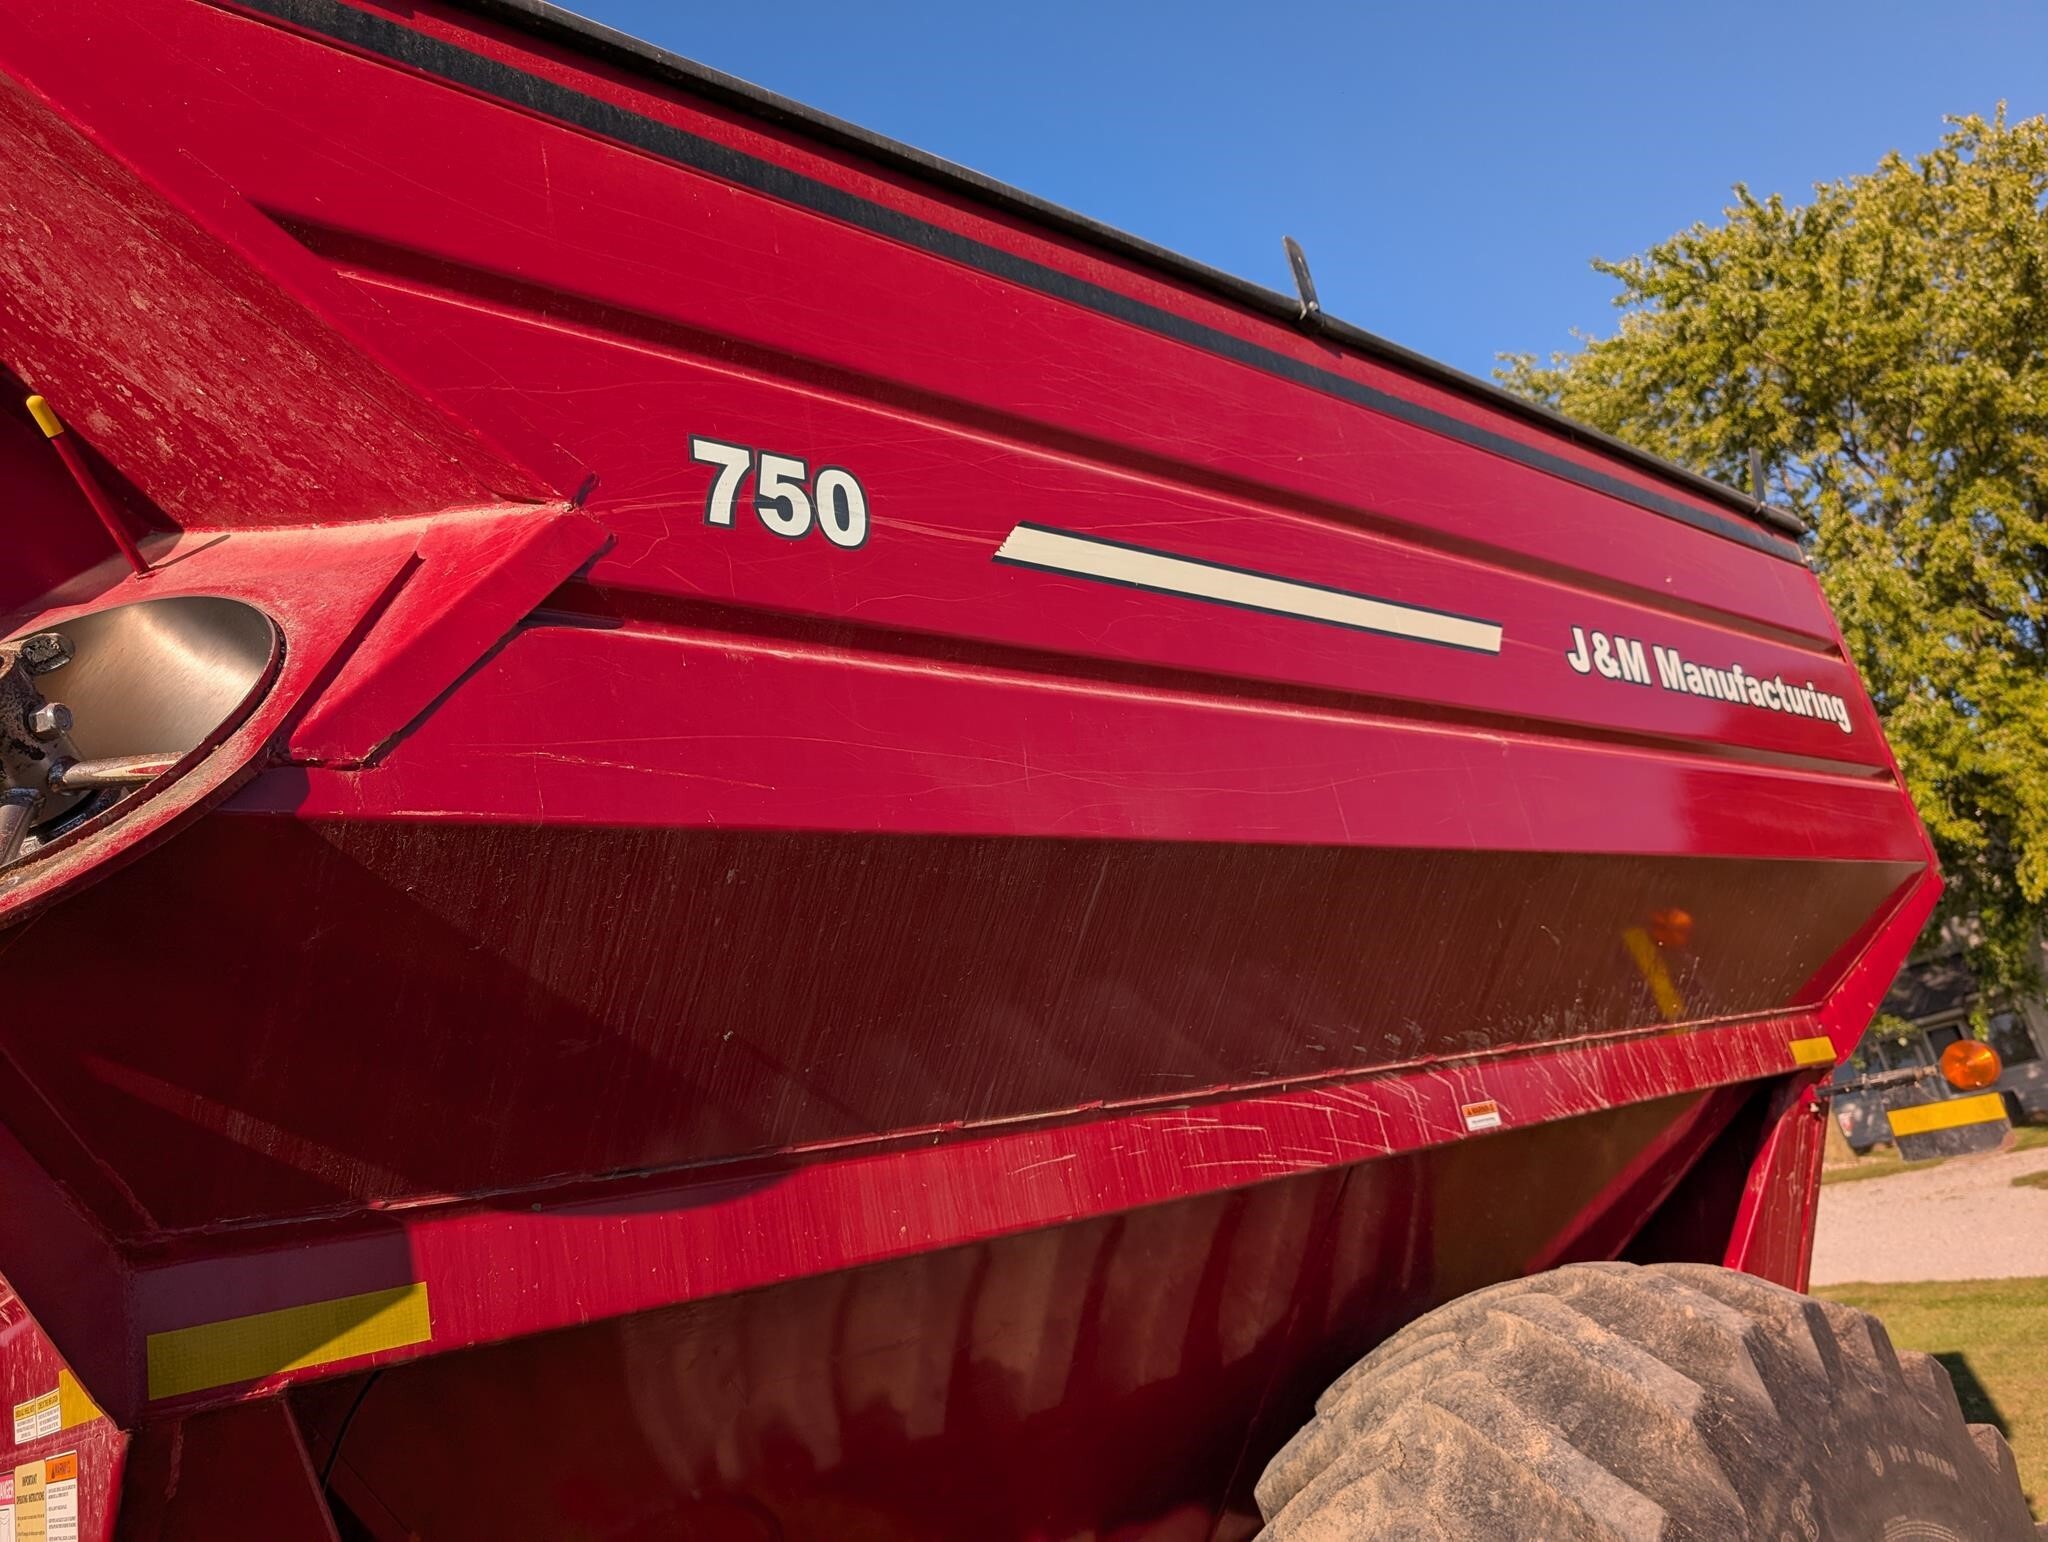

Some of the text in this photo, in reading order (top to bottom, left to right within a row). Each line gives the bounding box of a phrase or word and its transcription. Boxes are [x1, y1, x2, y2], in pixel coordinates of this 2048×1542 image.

[690, 435, 869, 549] 750
[1567, 626, 1852, 734] J&M Manufacturing
